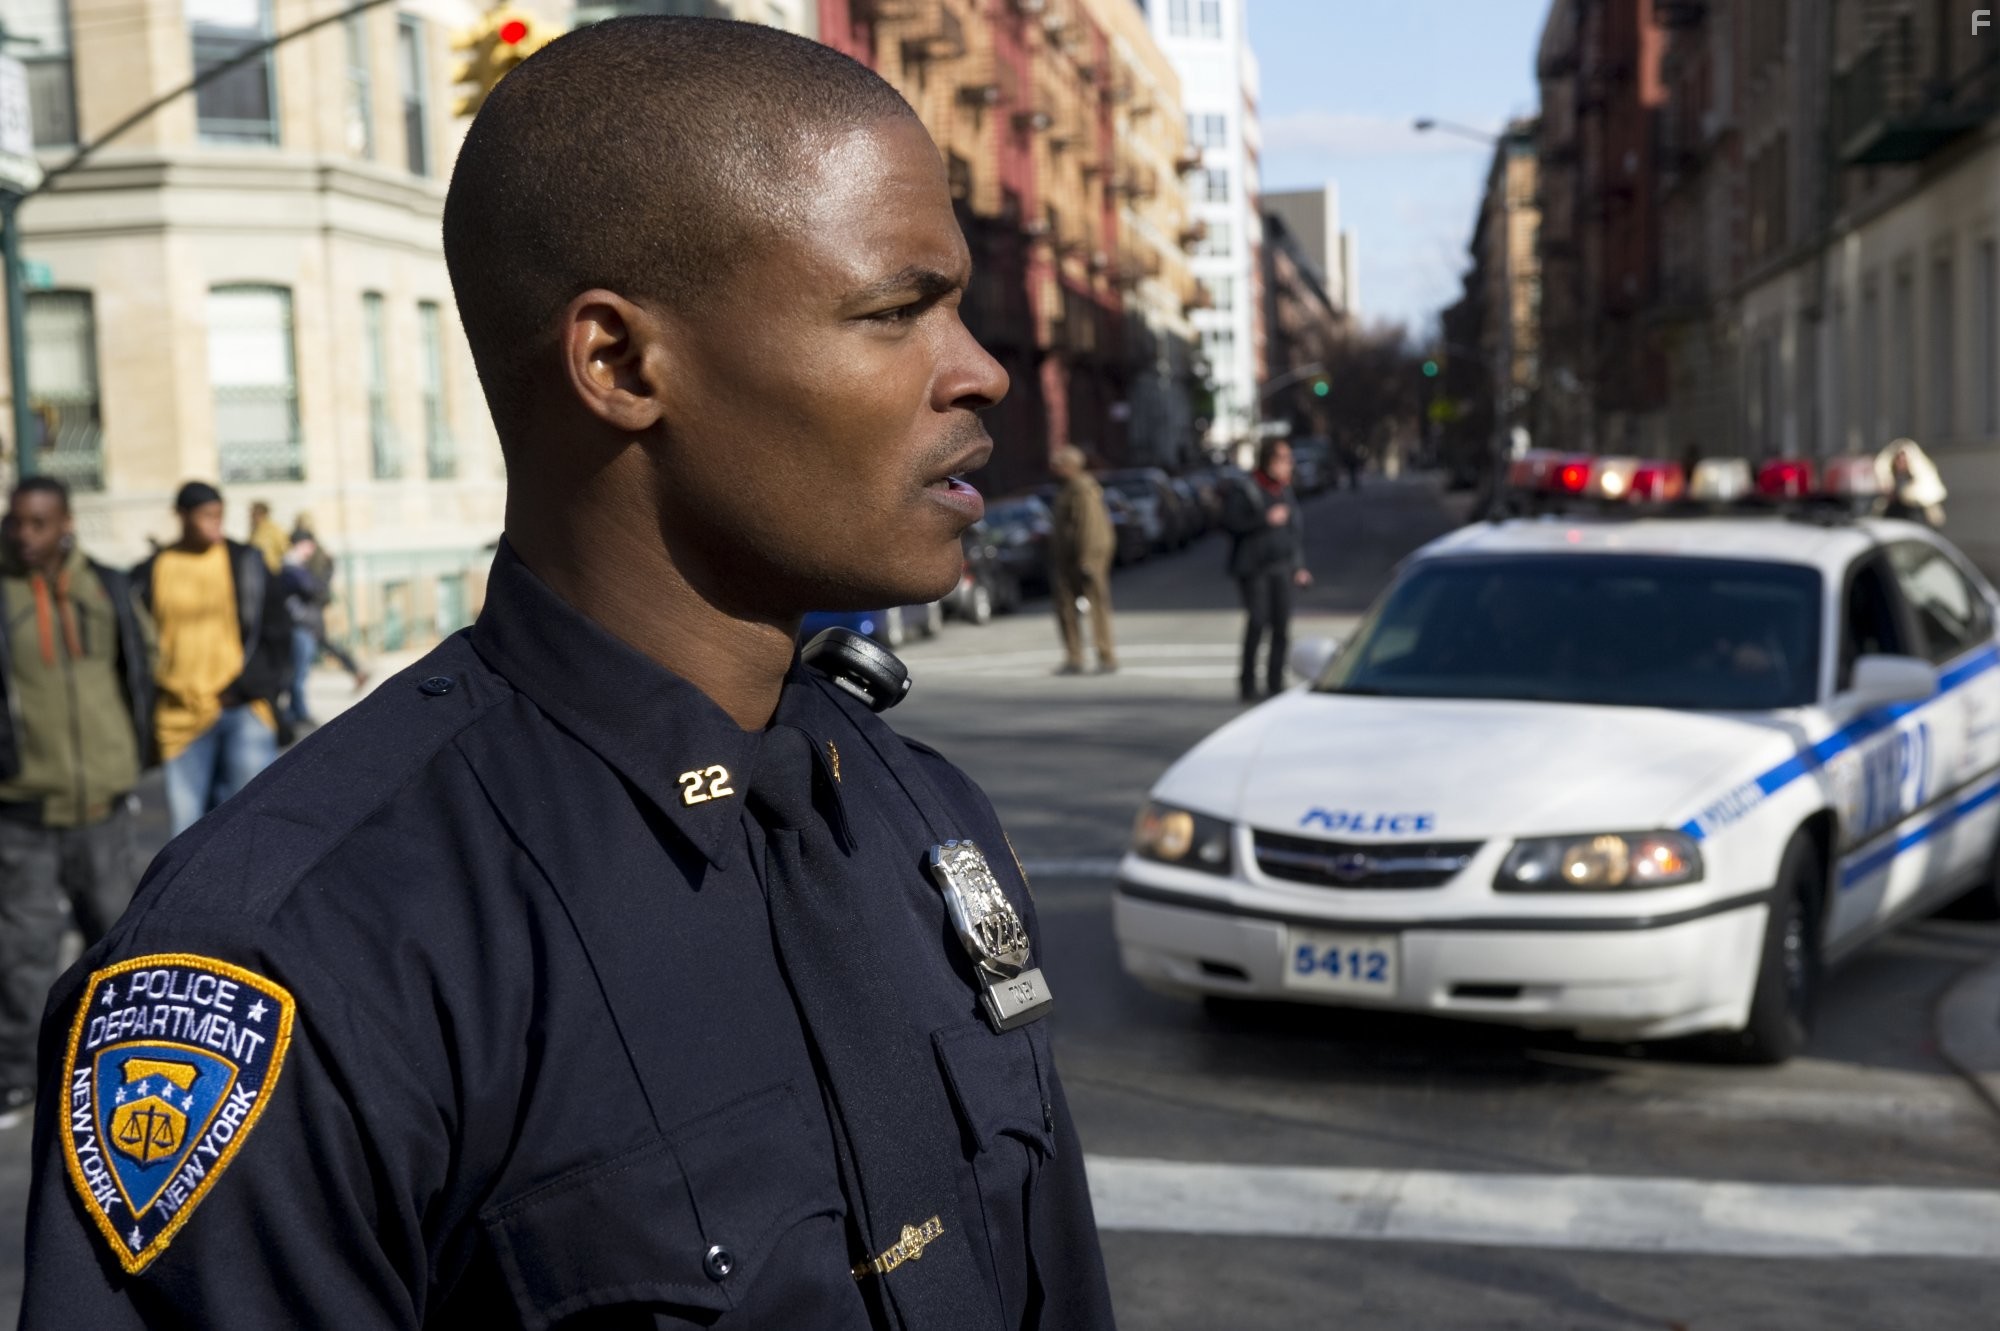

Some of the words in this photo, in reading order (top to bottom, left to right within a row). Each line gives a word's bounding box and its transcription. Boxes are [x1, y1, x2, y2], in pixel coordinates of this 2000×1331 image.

[678, 764, 735, 805] 22
[1300, 808, 1434, 832] POLICE
[1294, 944, 1389, 982] 5412
[127, 970, 239, 1013] POLICE
[86, 1005, 266, 1065] DEPARTMENT
[73, 1066, 93, 1133] NEW
[77, 1135, 122, 1214] YORK
[154, 1153, 207, 1222] NEW
[199, 1082, 257, 1158] YORK
